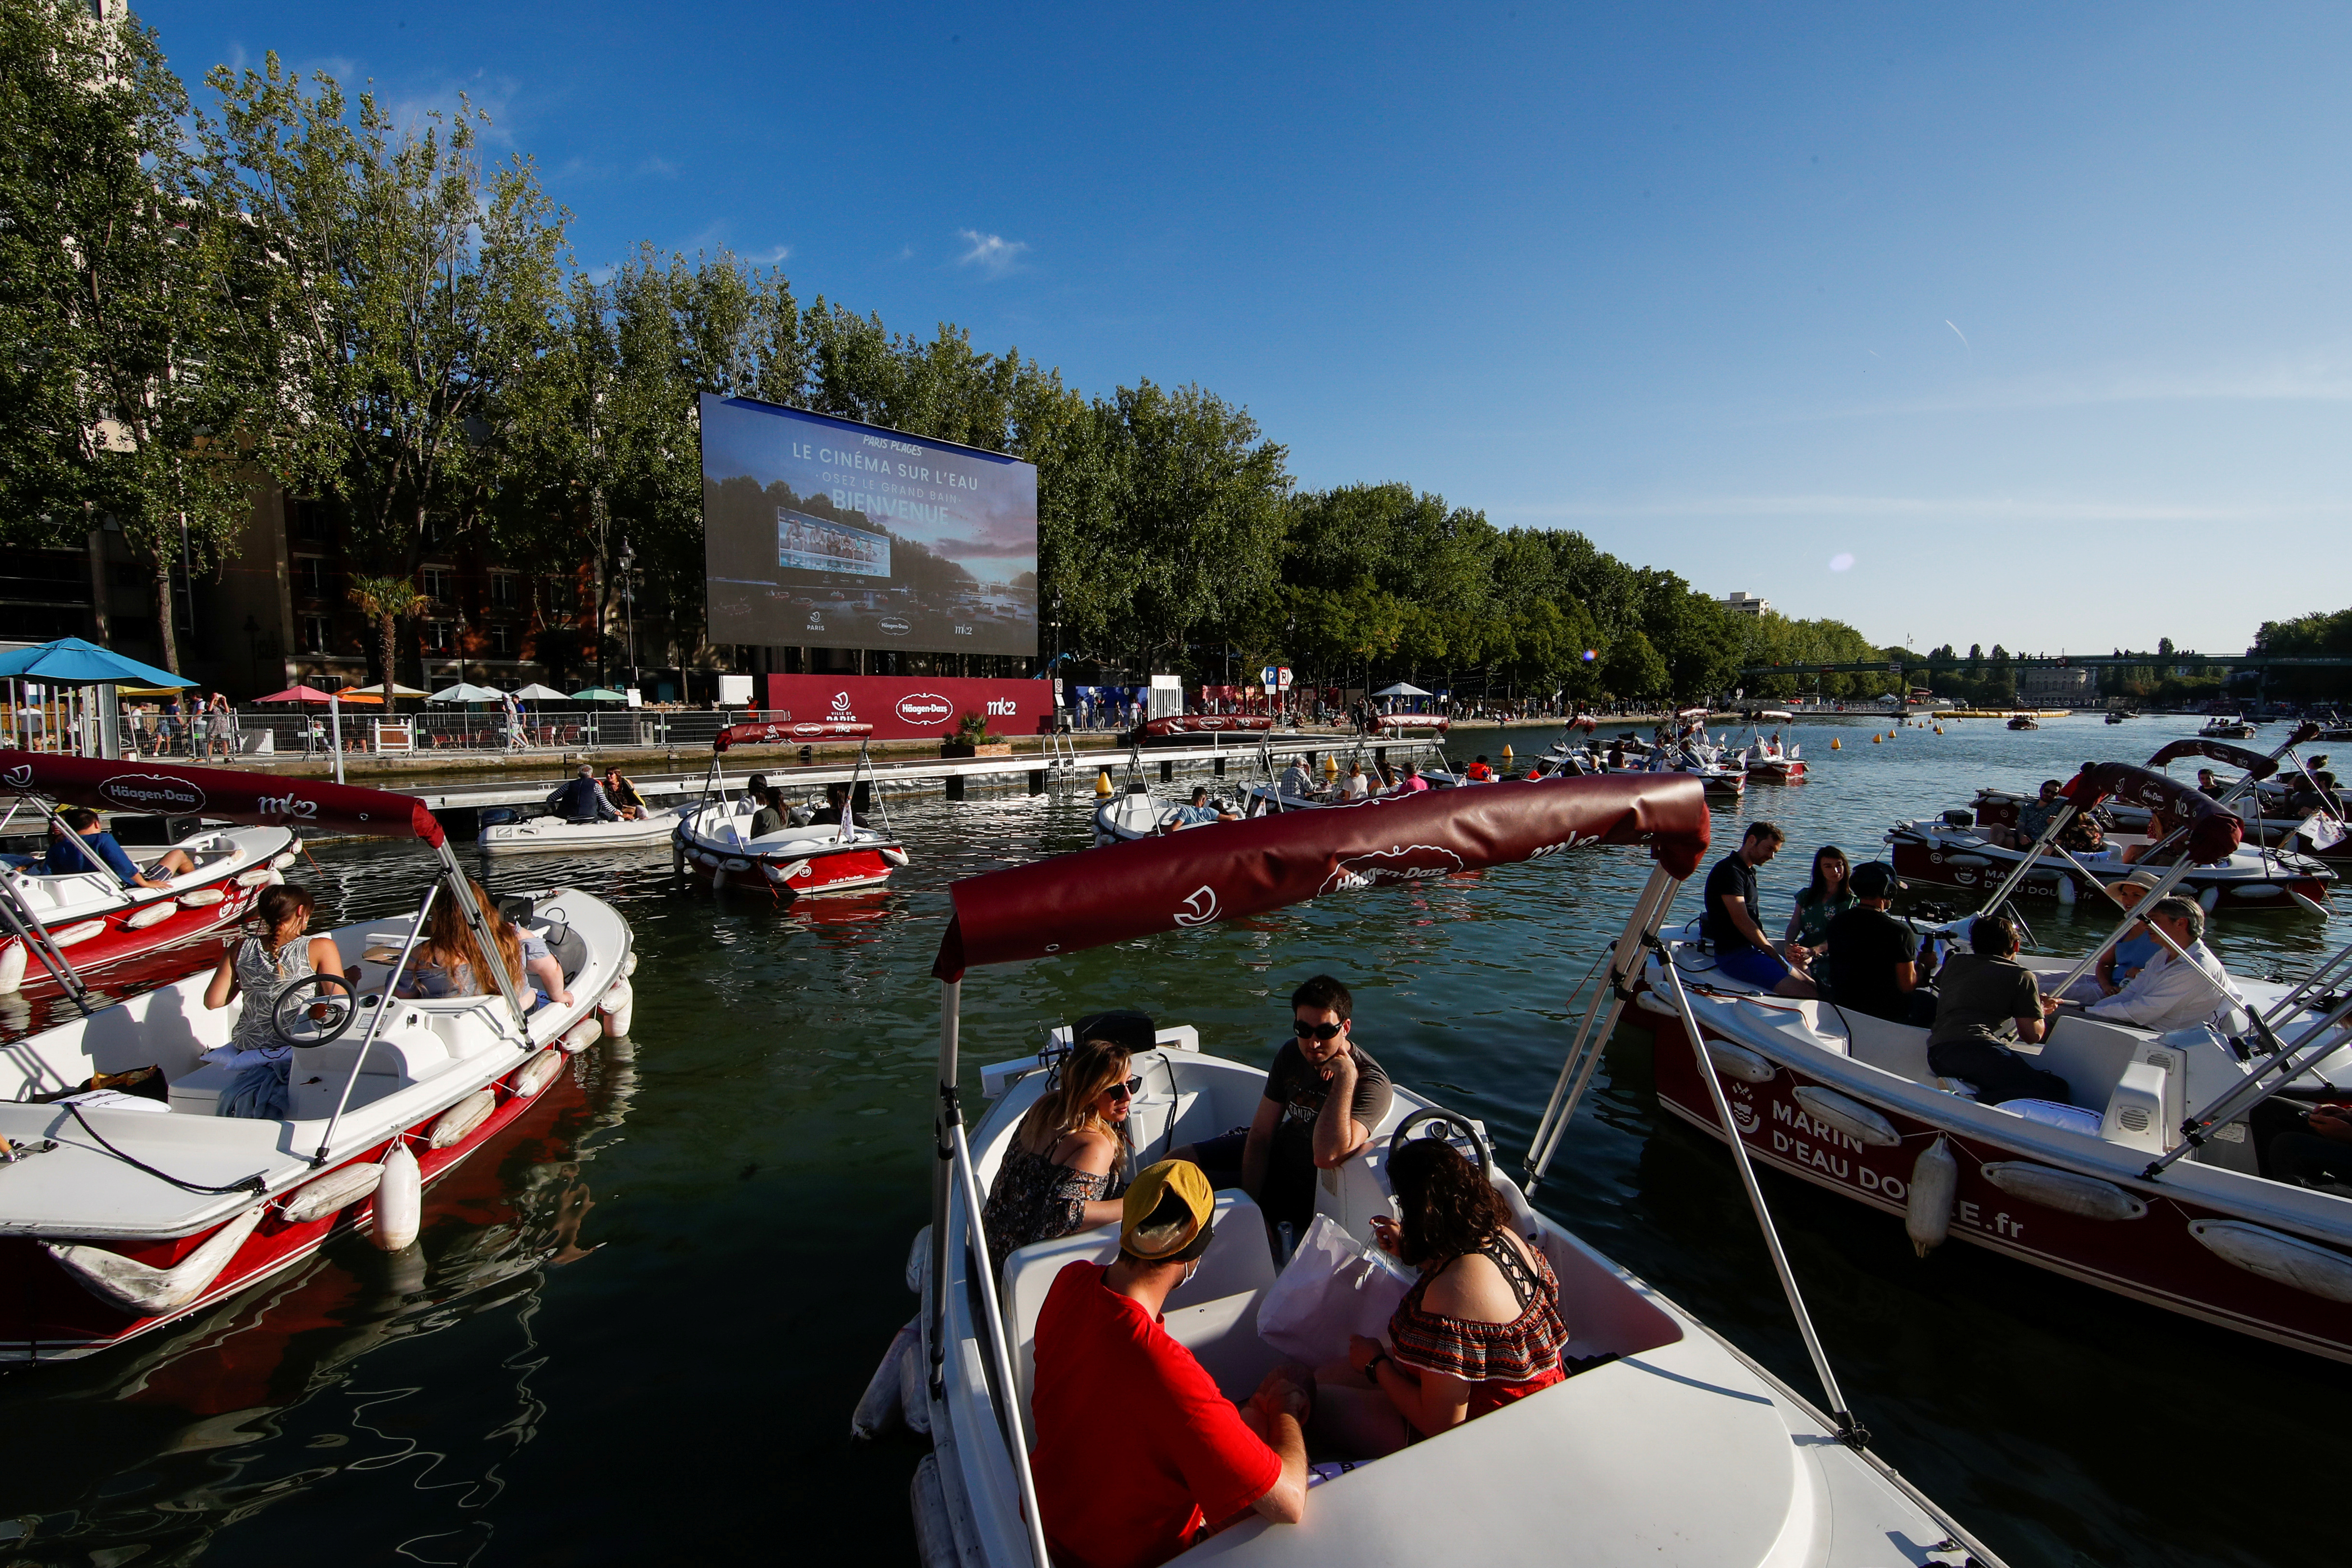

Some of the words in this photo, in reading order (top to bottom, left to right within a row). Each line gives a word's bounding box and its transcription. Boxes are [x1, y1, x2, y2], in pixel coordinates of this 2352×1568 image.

[863, 434, 888, 448] PARIS
[891, 441, 922, 456] PLAGES
[793, 442, 811, 459] LE
[820, 448, 891, 474] CINÉMA
[898, 463, 929, 482] SUR
[936, 471, 977, 490] L'EAU
[822, 472, 855, 486] OSEZ
[863, 479, 874, 489] LE
[882, 483, 923, 497] GRAND
[930, 491, 956, 503] BAIN
[833, 488, 948, 525] BIENVENUE
[955, 624, 972, 635] mk2
[1268, 671, 1274, 682] P
[902, 704, 947, 714] Häagen-Dazs
[987, 697, 1016, 715] mk2
[835, 724, 850, 732] mk2
[110, 785, 195, 803] Häagen-Dazs
[258, 793, 318, 819] mk2
[1335, 867, 1448, 892] Häagen-Dazs
[1773, 1130, 1848, 1178] D'EAU
[1859, 1166, 2023, 1238] DOE.fr
